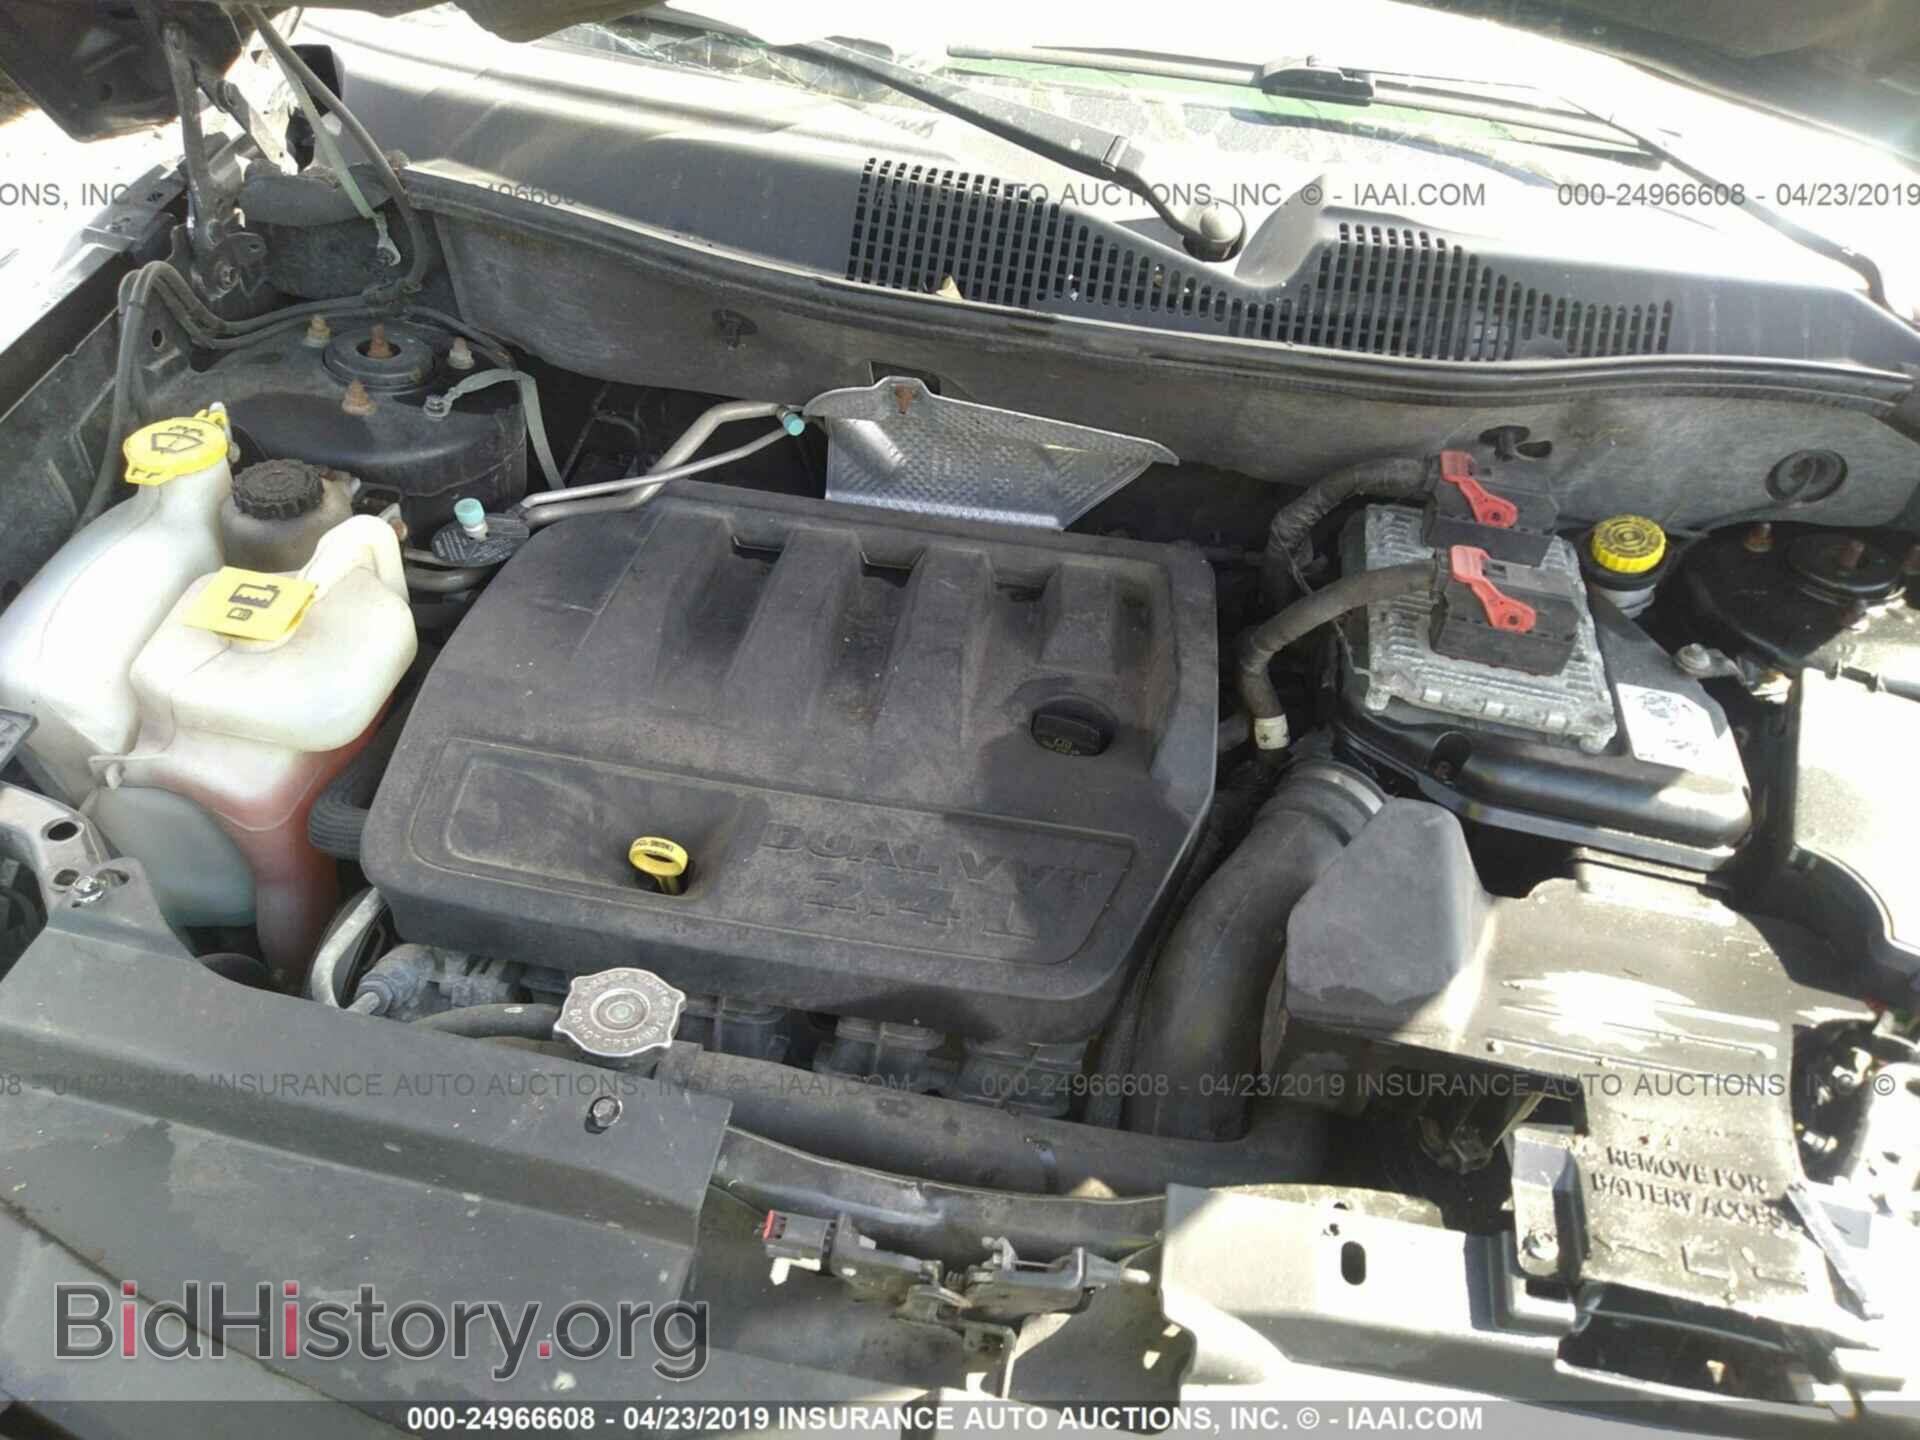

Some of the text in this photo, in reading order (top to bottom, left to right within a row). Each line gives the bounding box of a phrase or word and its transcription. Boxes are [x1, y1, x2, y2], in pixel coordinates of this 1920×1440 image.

[1591, 1172, 1691, 1212] BATTERY
[1607, 1146, 1767, 1195] REMOVE FOR
